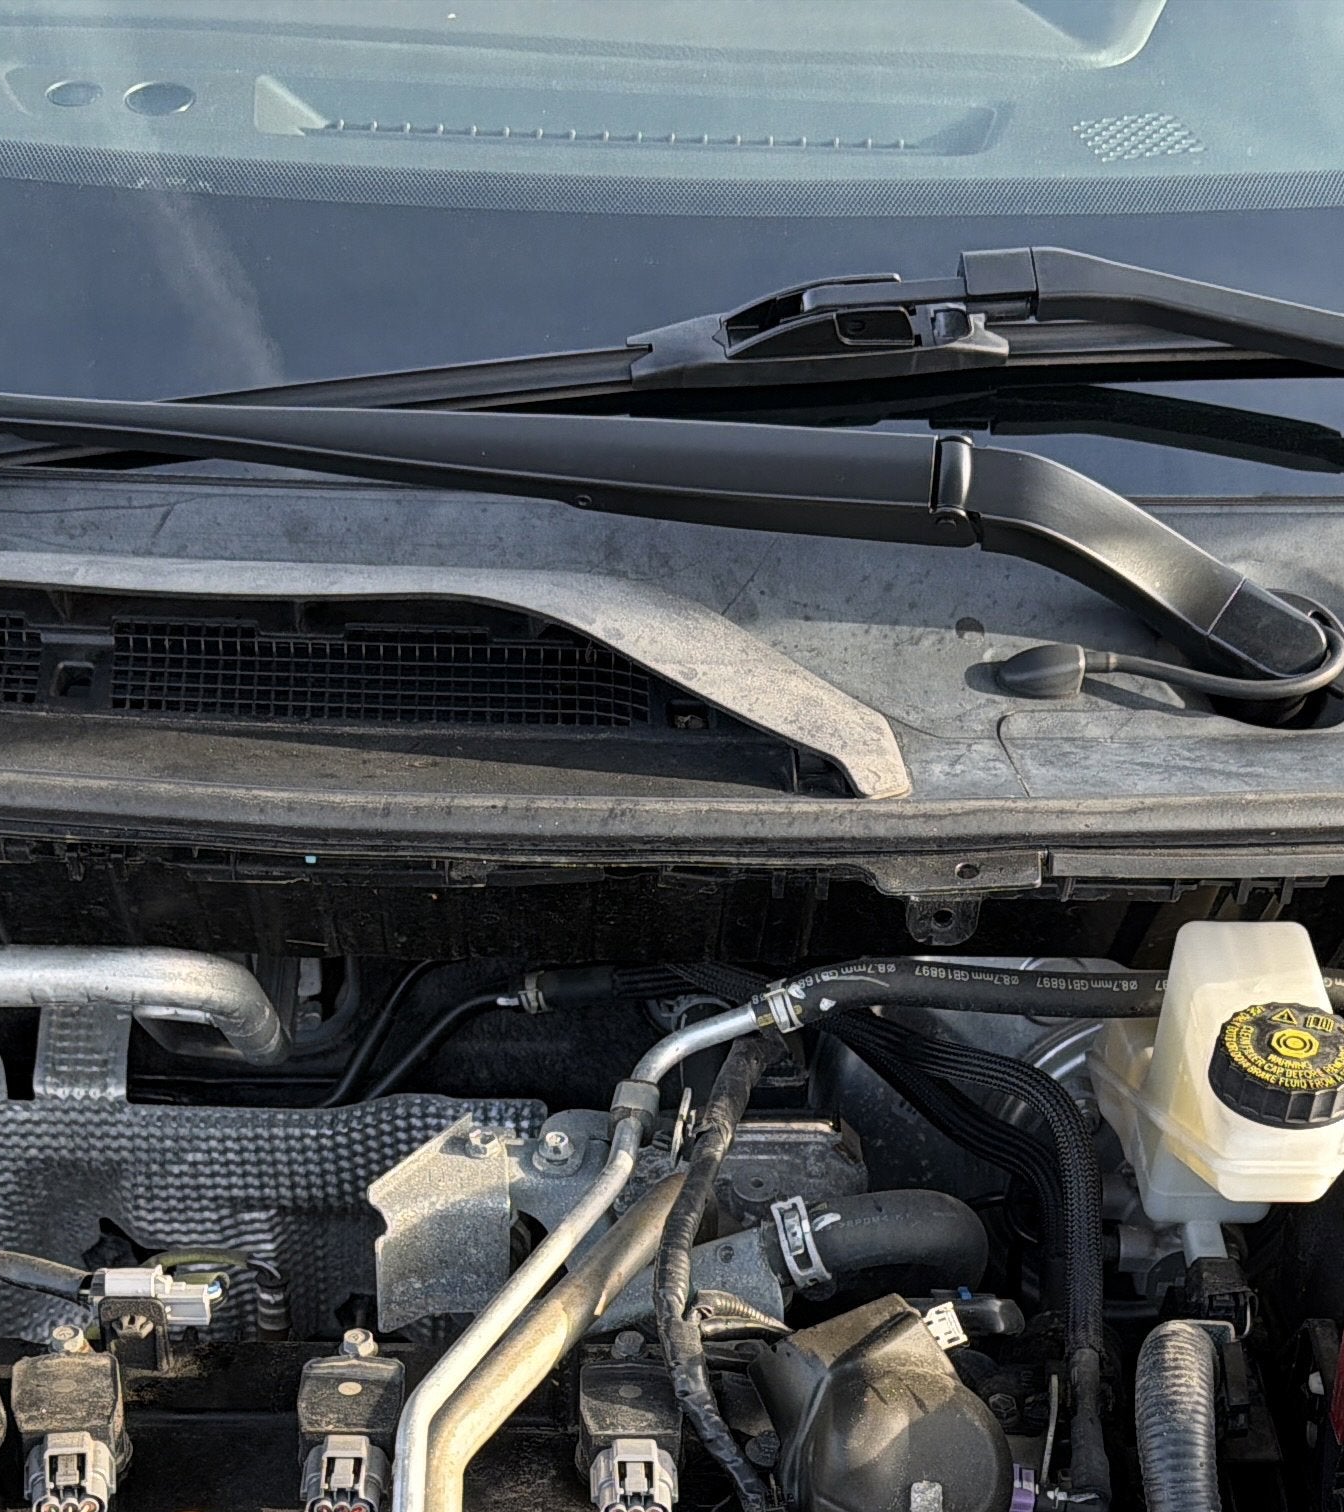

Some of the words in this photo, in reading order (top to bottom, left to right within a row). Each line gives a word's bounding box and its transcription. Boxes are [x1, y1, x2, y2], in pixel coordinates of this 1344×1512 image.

[797, 968, 839, 990] GB168
[914, 964, 970, 982] GB16897
[1036, 975, 1089, 991] GB16897
[1260, 1061, 1285, 1076] CAP
[1283, 1067, 1326, 1079] BEFORE
[1268, 1052, 1313, 1070] WARNING
[1244, 1063, 1278, 1084] BRAKE
[1276, 1076, 1308, 1089] FLUID
[1307, 1074, 1339, 1090] FROM
